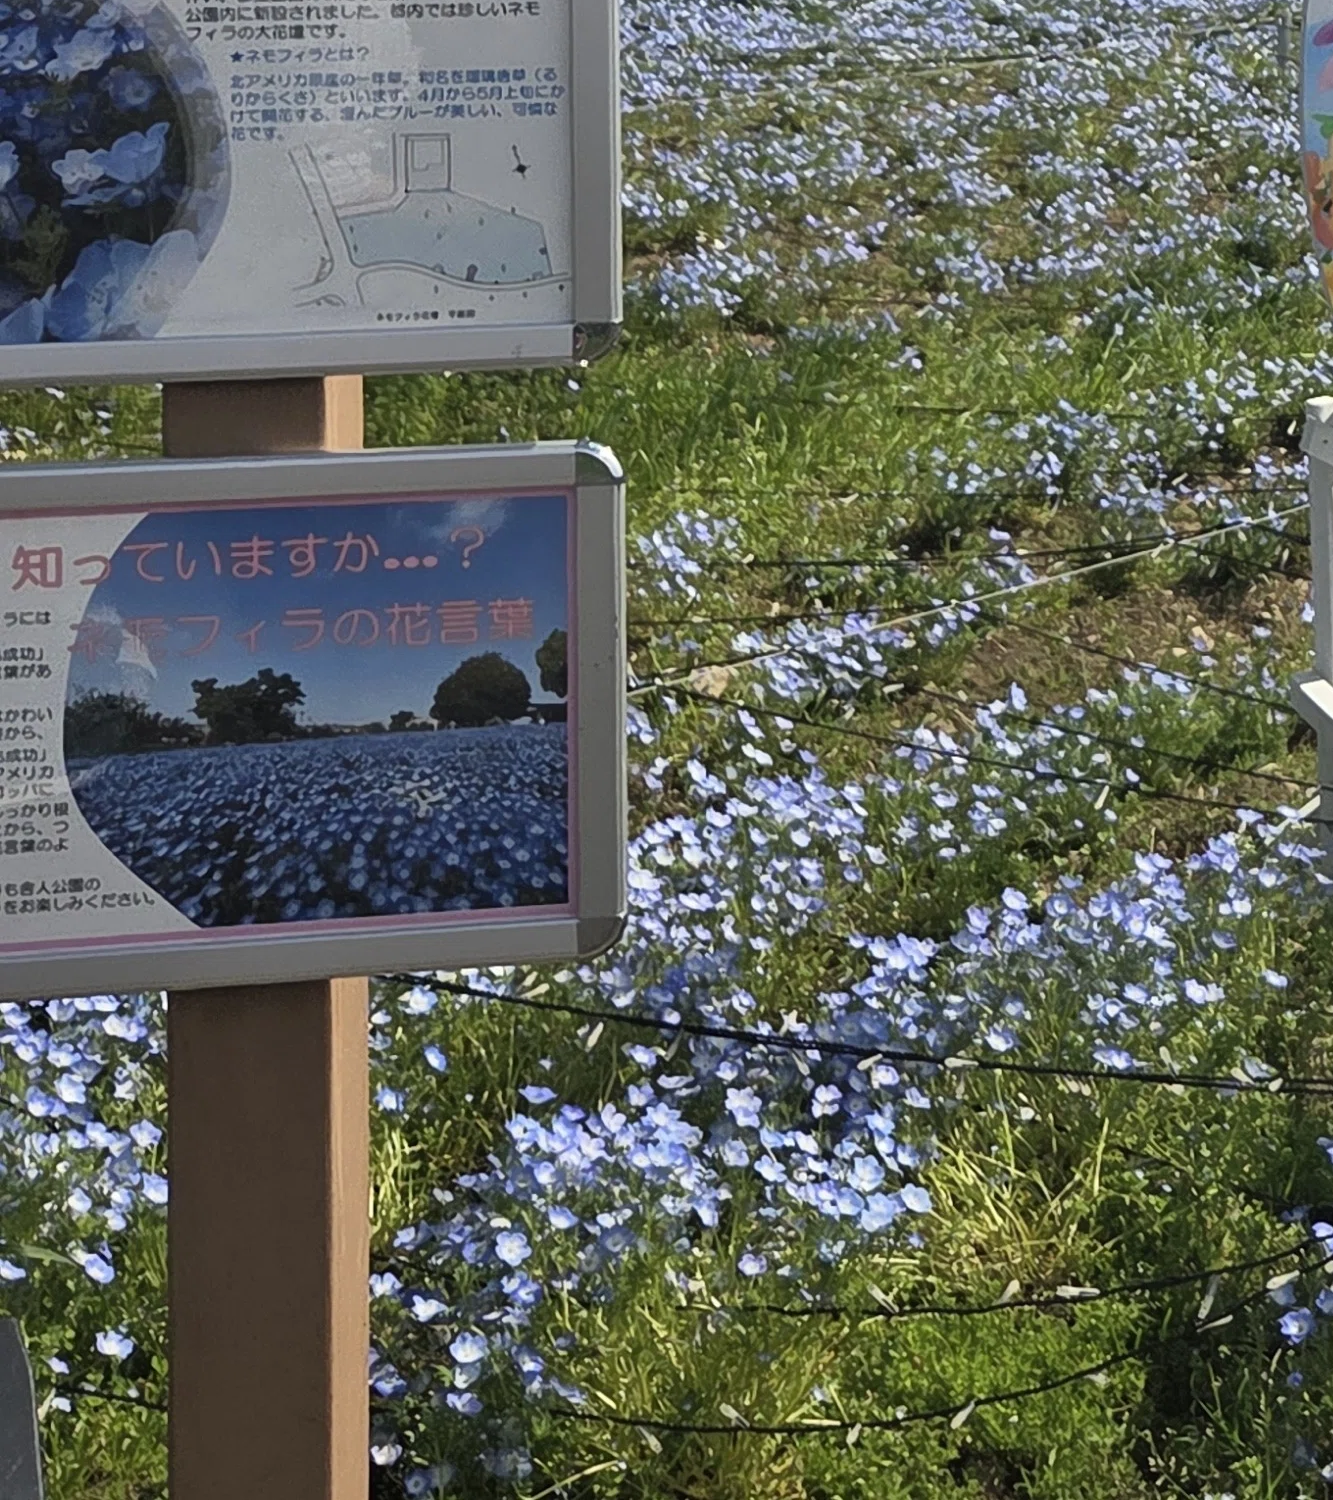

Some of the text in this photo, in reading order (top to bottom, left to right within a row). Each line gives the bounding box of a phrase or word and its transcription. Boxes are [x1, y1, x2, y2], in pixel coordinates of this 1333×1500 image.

[0, 647, 43, 662] 成功」
[0, 663, 52, 679] 葉があ
[0, 725, 43, 741] から、
[0, 748, 46, 763] 成功」
[0, 802, 69, 818] っかり根
[0, 820, 69, 837] から、つ
[0, 837, 69, 855] 言葉のよ
[0, 877, 101, 897] も舎人公園の
[0, 891, 155, 915] をお楽しみください。
